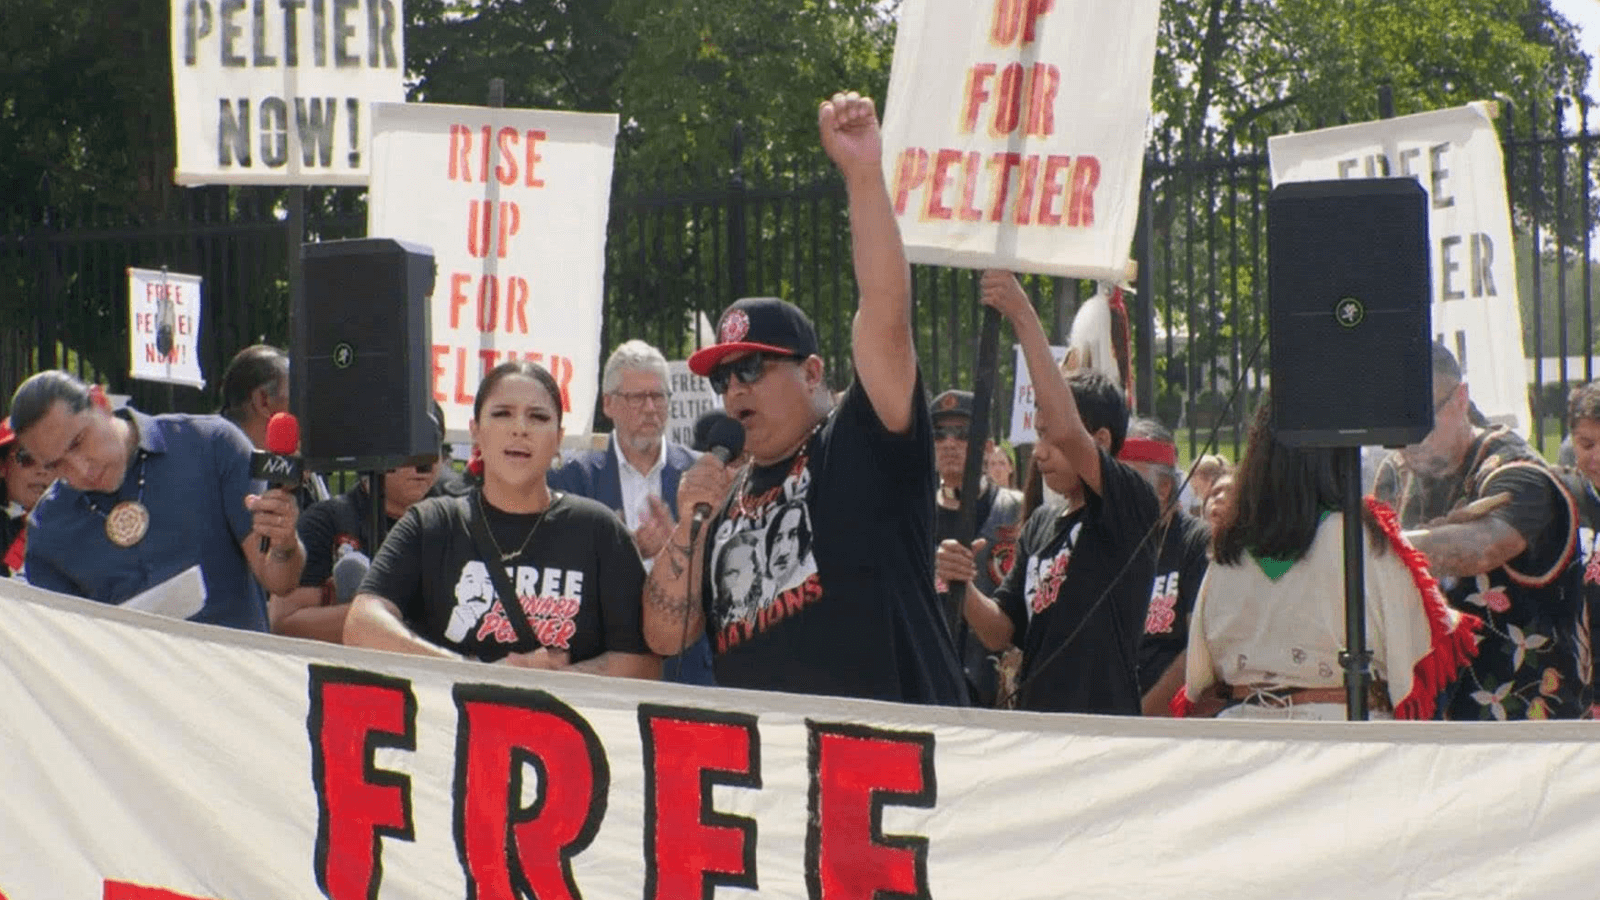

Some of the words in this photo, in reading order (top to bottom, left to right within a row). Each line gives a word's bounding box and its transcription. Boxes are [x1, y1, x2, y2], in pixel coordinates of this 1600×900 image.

[184, 0, 398, 69] PELTIER
[217, 96, 361, 168] NOW!
[960, 61, 1061, 138] FOR
[447, 123, 547, 189] RISE
[893, 147, 1102, 228] PELTIER
[467, 199, 521, 259] UP
[449, 272, 530, 335] FOR
[672, 373, 707, 392] FREE
[308, 664, 938, 900] FREE
